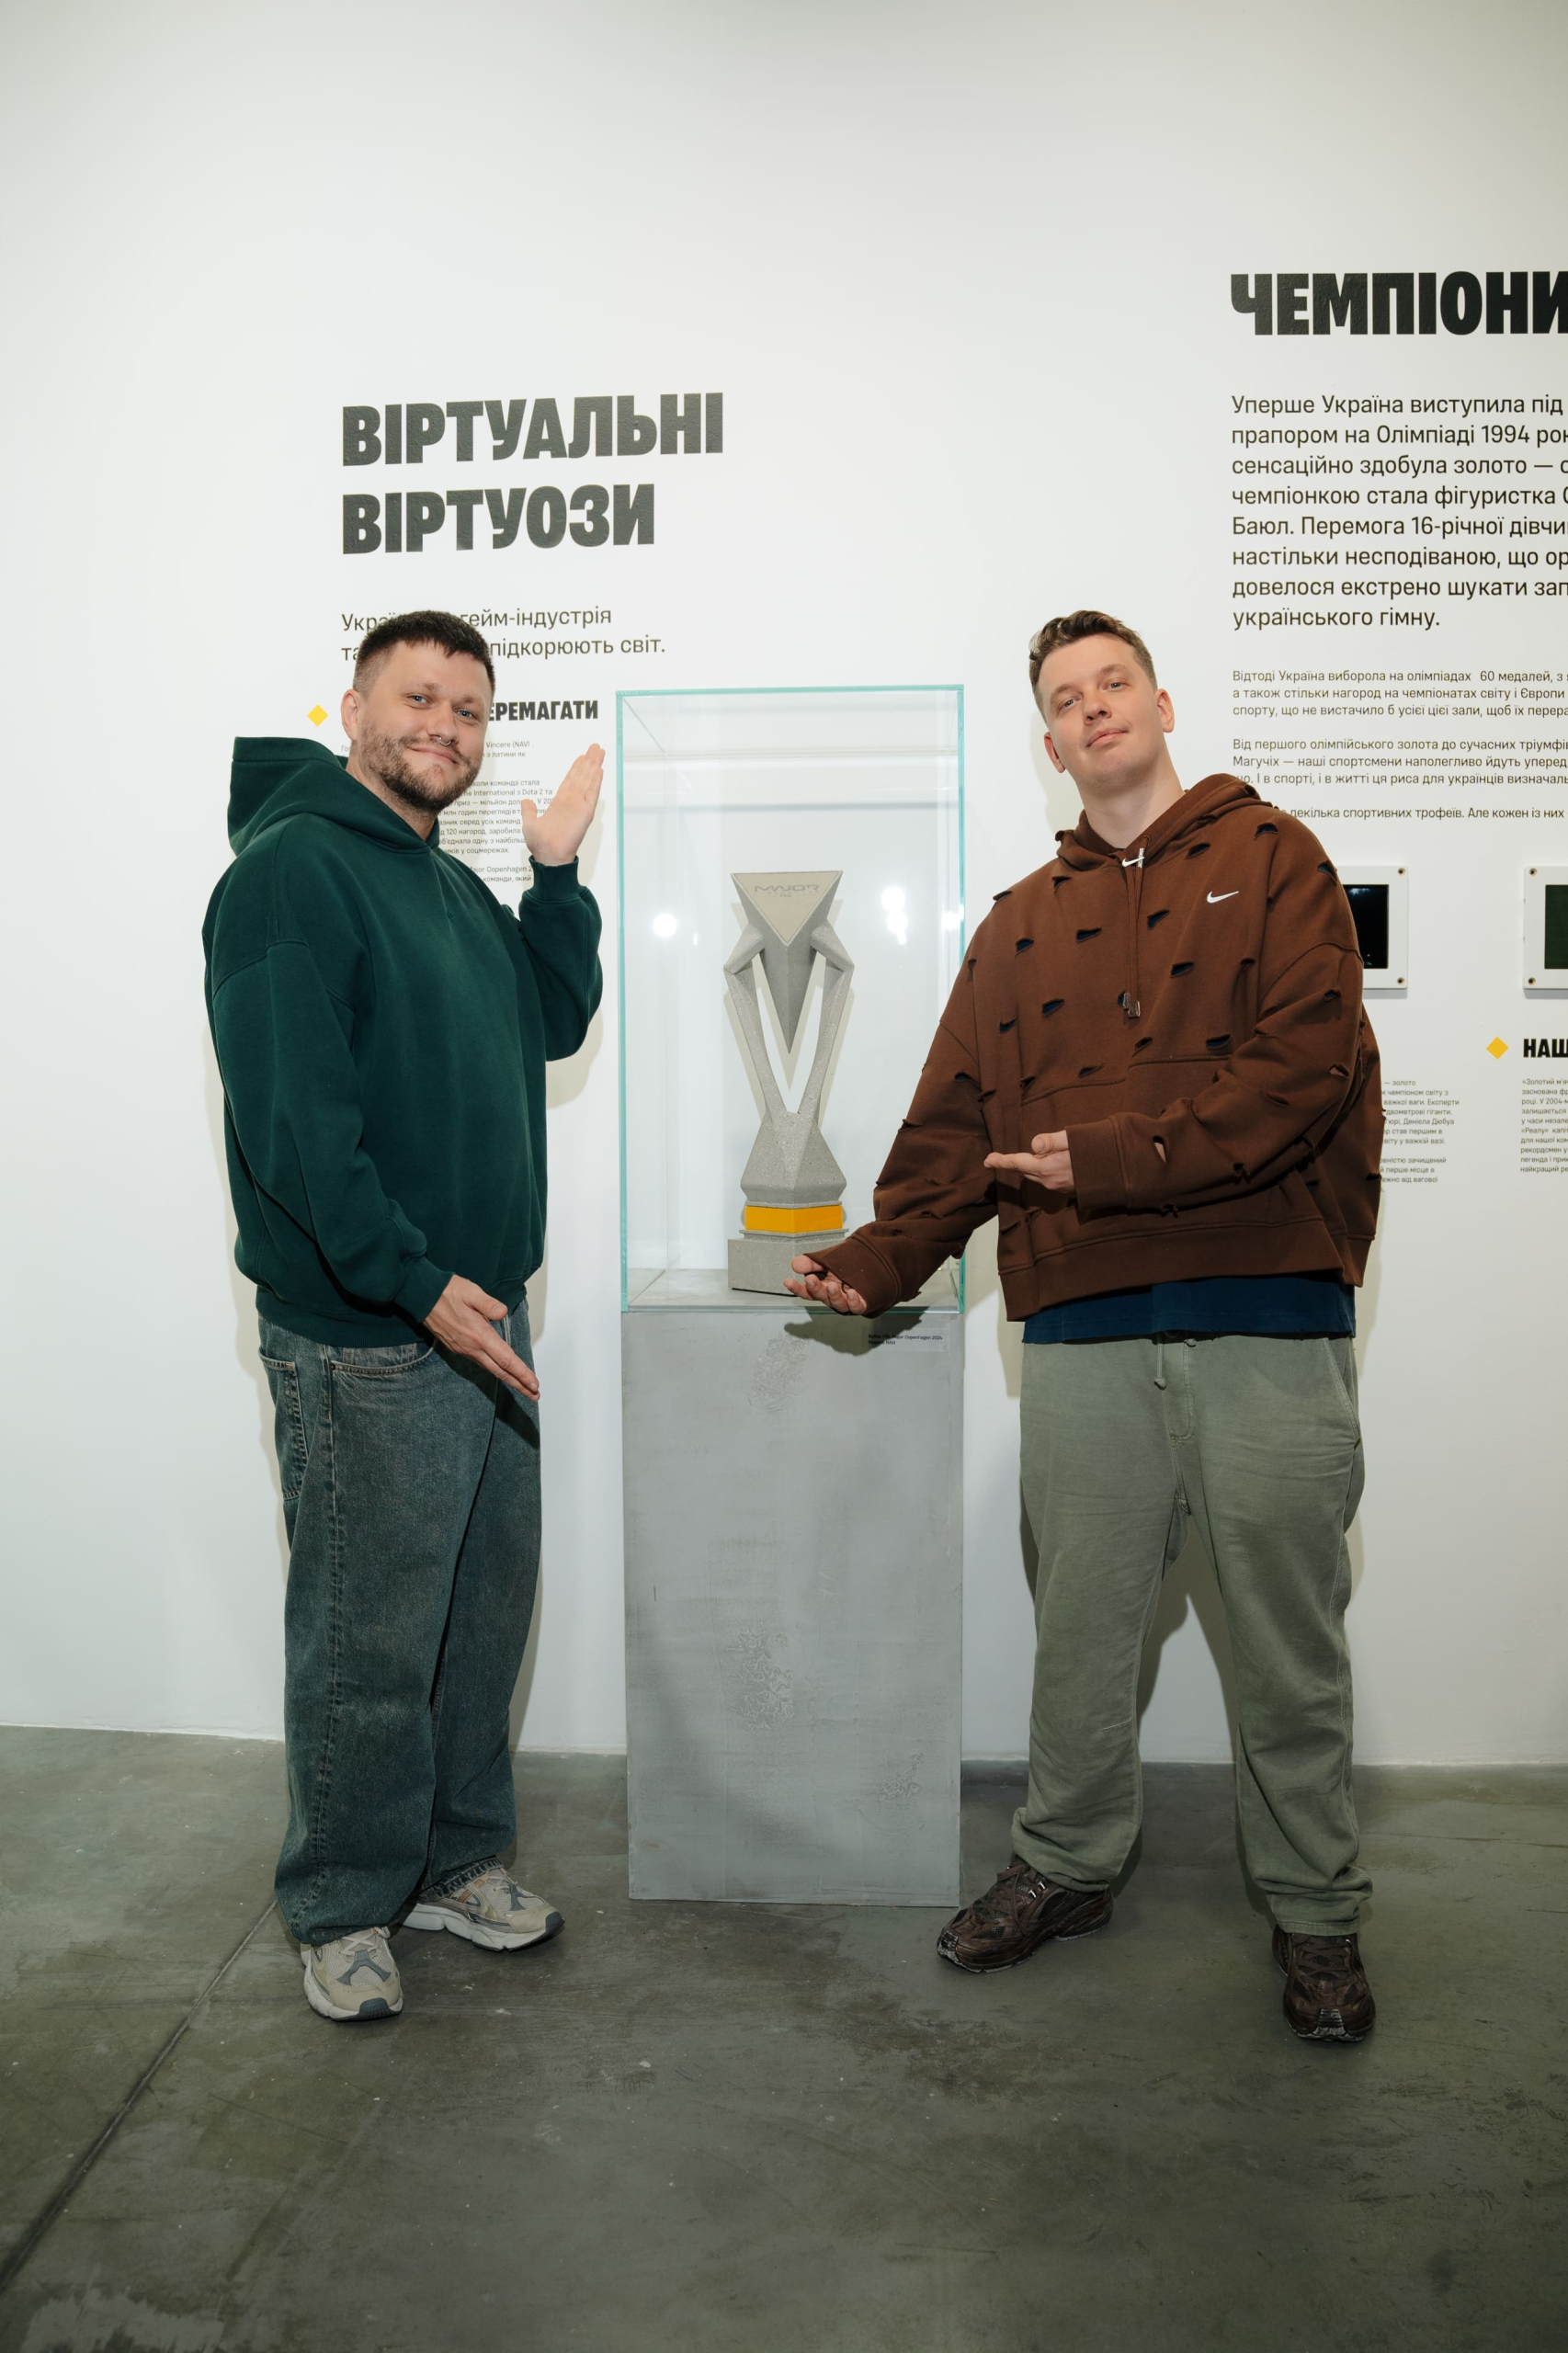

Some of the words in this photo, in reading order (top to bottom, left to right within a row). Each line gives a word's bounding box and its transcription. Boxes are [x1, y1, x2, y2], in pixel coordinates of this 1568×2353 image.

[1231, 270, 1568, 335] ЧЕМПІОНИ
[1232, 395, 1314, 418] Уперше
[1322, 395, 1403, 418] Україна
[1411, 399, 1525, 418] виступила
[1532, 393, 1563, 416] під
[343, 392, 723, 467] ВІРТУАЛЬНІ
[1233, 429, 1337, 449] прапором
[1346, 429, 1369, 443] на
[1378, 425, 1474, 447] Олімпіаді
[1482, 425, 1530, 443] 1994
[1233, 455, 1353, 477] сенсаційно
[1360, 454, 1447, 479] здобула
[1454, 460, 1527, 474] золото
[1233, 485, 1359, 505] чемпіонкою
[1368, 490, 1427, 505] стала
[1435, 485, 1555, 509] фігуристка
[343, 483, 654, 555] ВІРТУОЗИ
[1233, 517, 1294, 535] Баюл.
[1302, 517, 1404, 540] Перемога
[1412, 516, 1505, 540] 16-річної
[1510, 516, 1568, 538] дівчи
[1233, 546, 1338, 565] настільки
[1346, 546, 1501, 569] несподіваною,
[1509, 551, 1539, 568] що
[1233, 581, 1334, 598] довелося
[1342, 581, 1440, 600] екстрено
[1449, 581, 1528, 600] шукати
[1233, 608, 1373, 631] українського
[1381, 607, 1439, 631] гімну.
[489, 637, 614, 659] підкорюють
[621, 634, 665, 654] світ.
[1233, 670, 1275, 683] Відтоді
[1279, 670, 1324, 684] Україна
[1329, 670, 1386, 684] виборола
[1390, 673, 1403, 681] на
[1407, 670, 1471, 683] олімпіадах
[1481, 670, 1495, 682] 60
[1499, 670, 1553, 684] медалей,
[1557, 673, 1563, 682] з
[1244, 689, 1280, 699] також
[1284, 688, 1329, 699] стільки
[1333, 689, 1381, 700] нагород
[1385, 689, 1399, 699] на
[1403, 688, 1477, 699] чемпіонатах
[1481, 688, 1511, 701] світу
[1521, 688, 1565, 701] Європи
[489, 699, 598, 722] ЕРЕМАГАТИ
[1233, 707, 1278, 718] спорту,
[1282, 707, 1299, 717] що
[1303, 707, 1317, 715] не
[1321, 707, 1384, 715] вистачило
[1388, 704, 1395, 715] б
[1399, 704, 1426, 718] усієї
[1428, 704, 1449, 717] цієї
[1452, 707, 1483, 718] зали,
[1487, 704, 1512, 717] щоб
[1515, 705, 1524, 716] їх
[485, 740, 512, 749] Vincere
[491, 751, 517, 759] латини
[1233, 738, 1252, 751] Від
[1256, 741, 1307, 752] першого
[1311, 738, 1394, 749] олімпійського
[1398, 741, 1438, 749] золота
[1442, 741, 1457, 751] до
[1460, 741, 1516, 752] сучасних
[1233, 756, 1279, 769] Магучіх
[1299, 756, 1325, 767] наші
[1330, 758, 1402, 769] спортсмени
[1406, 758, 1483, 767] наполегливо
[1486, 756, 1521, 769] йдуть
[1525, 758, 1568, 769] уперед
[1264, 775, 1270, 783] в
[1274, 773, 1314, 786] спорті,
[1325, 775, 1332, 784] в
[1335, 773, 1369, 783] житті
[1373, 775, 1387, 785] ця
[1392, 775, 1419, 786] риса
[1423, 775, 1445, 785] для
[1449, 773, 1504, 786] українців
[472, 788, 517, 798] International
[522, 788, 539, 796] Dota
[1290, 807, 1340, 820] декілька
[1344, 809, 1412, 820] спортивних
[1415, 807, 1465, 820] трофеїв.
[1468, 807, 1489, 818] Але
[1493, 810, 1528, 818] кожен
[1532, 807, 1540, 818] із
[1544, 810, 1564, 818] них
[754, 884, 820, 892] MAJOR
